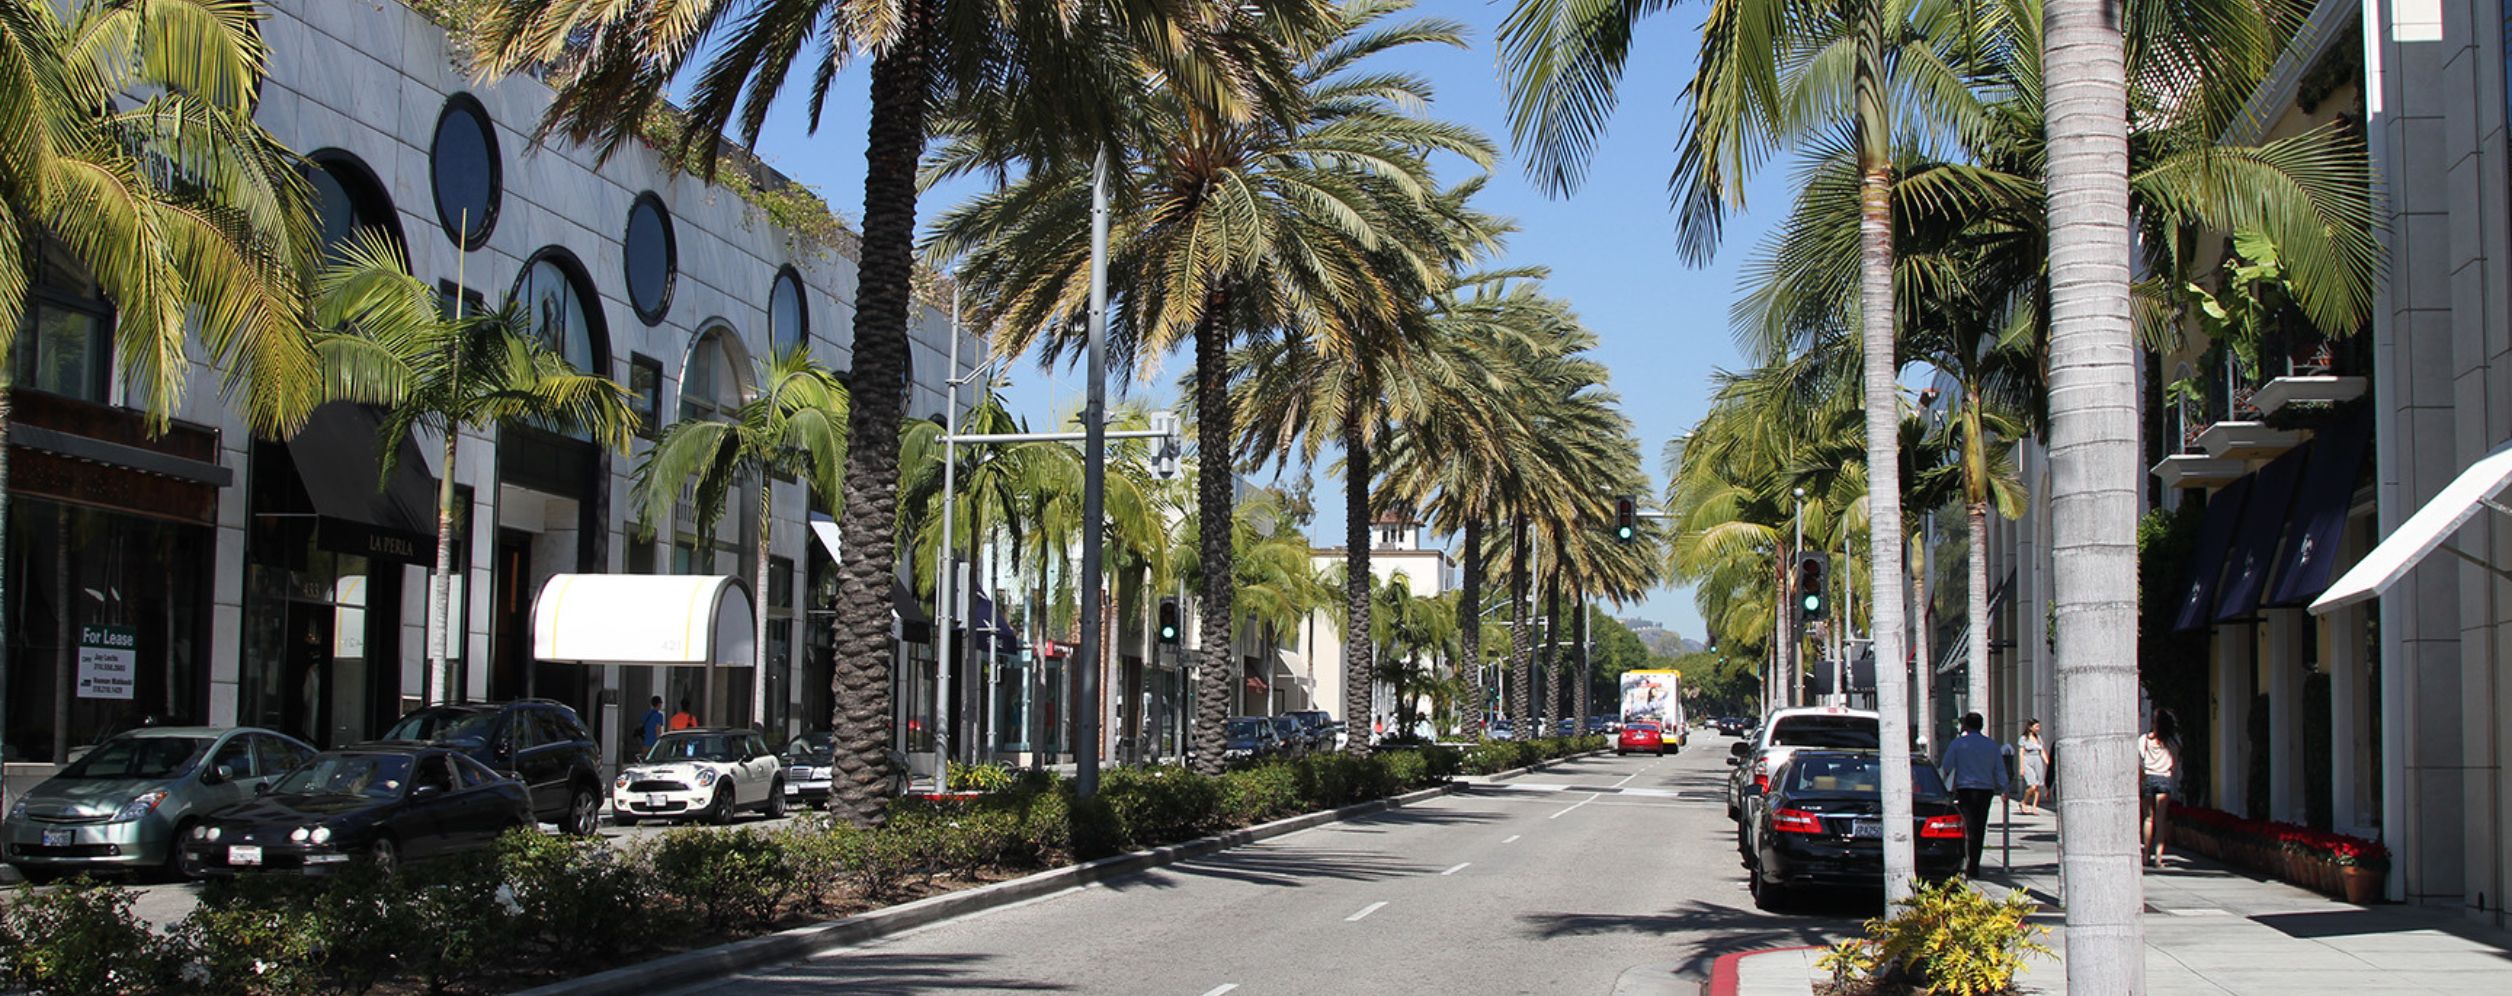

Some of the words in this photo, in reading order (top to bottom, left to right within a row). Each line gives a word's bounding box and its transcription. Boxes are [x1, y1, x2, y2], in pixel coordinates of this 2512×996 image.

[369, 534, 382, 551] LA
[384, 537, 414, 556] PERLA
[82, 628, 101, 643] For
[103, 629, 133, 646] Lease
